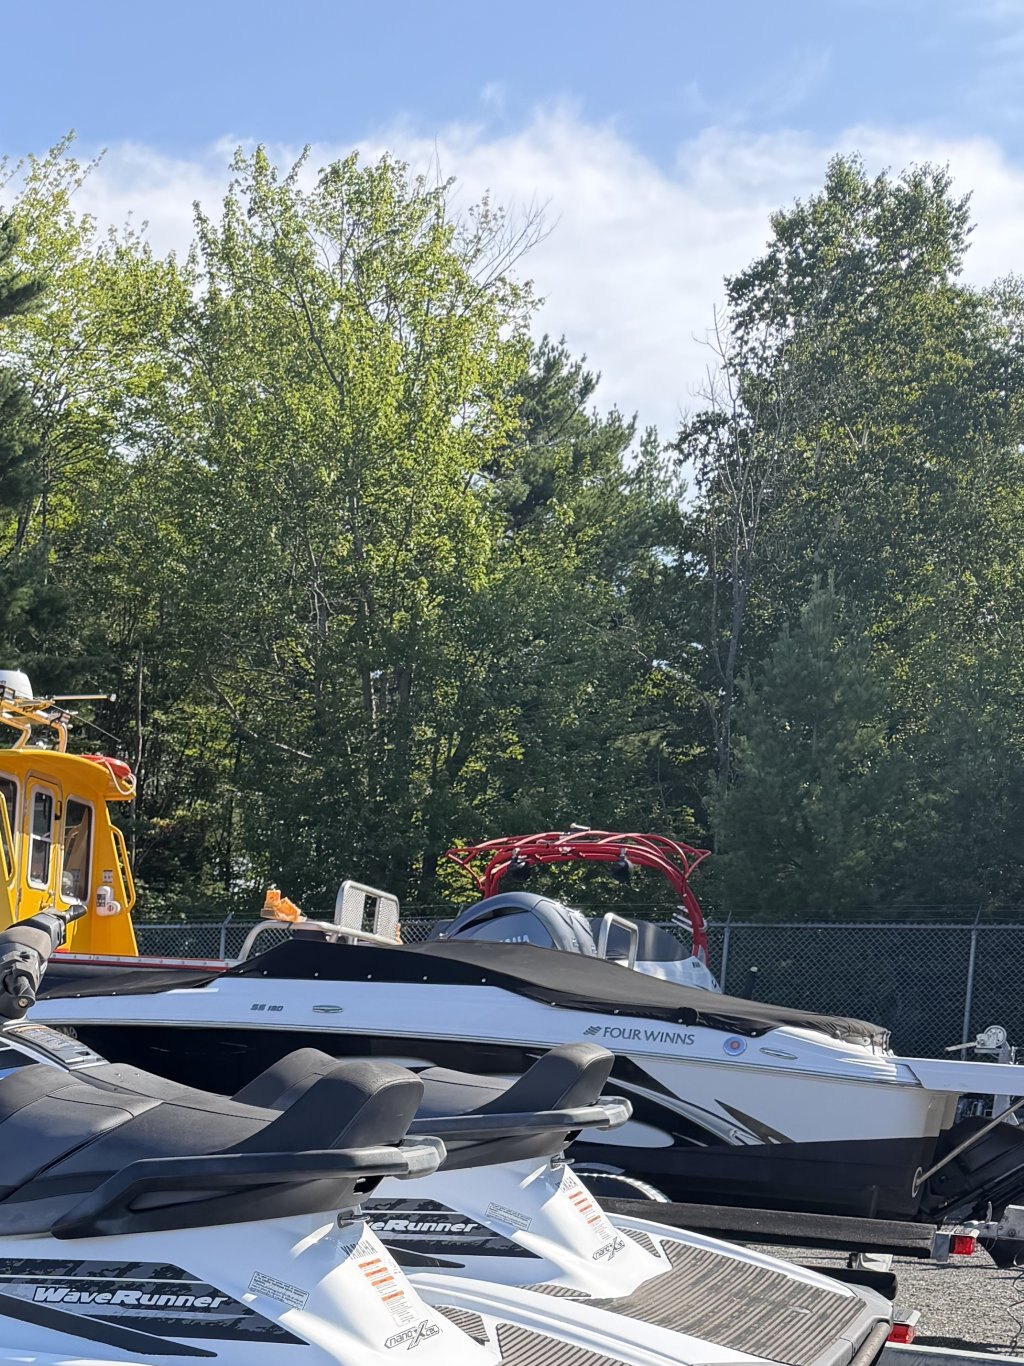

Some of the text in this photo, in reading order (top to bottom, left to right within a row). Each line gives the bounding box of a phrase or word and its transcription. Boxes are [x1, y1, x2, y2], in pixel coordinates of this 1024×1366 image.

[602, 1026, 696, 1045] FOUR WINNS
[33, 1286, 228, 1309] WaveRunner
